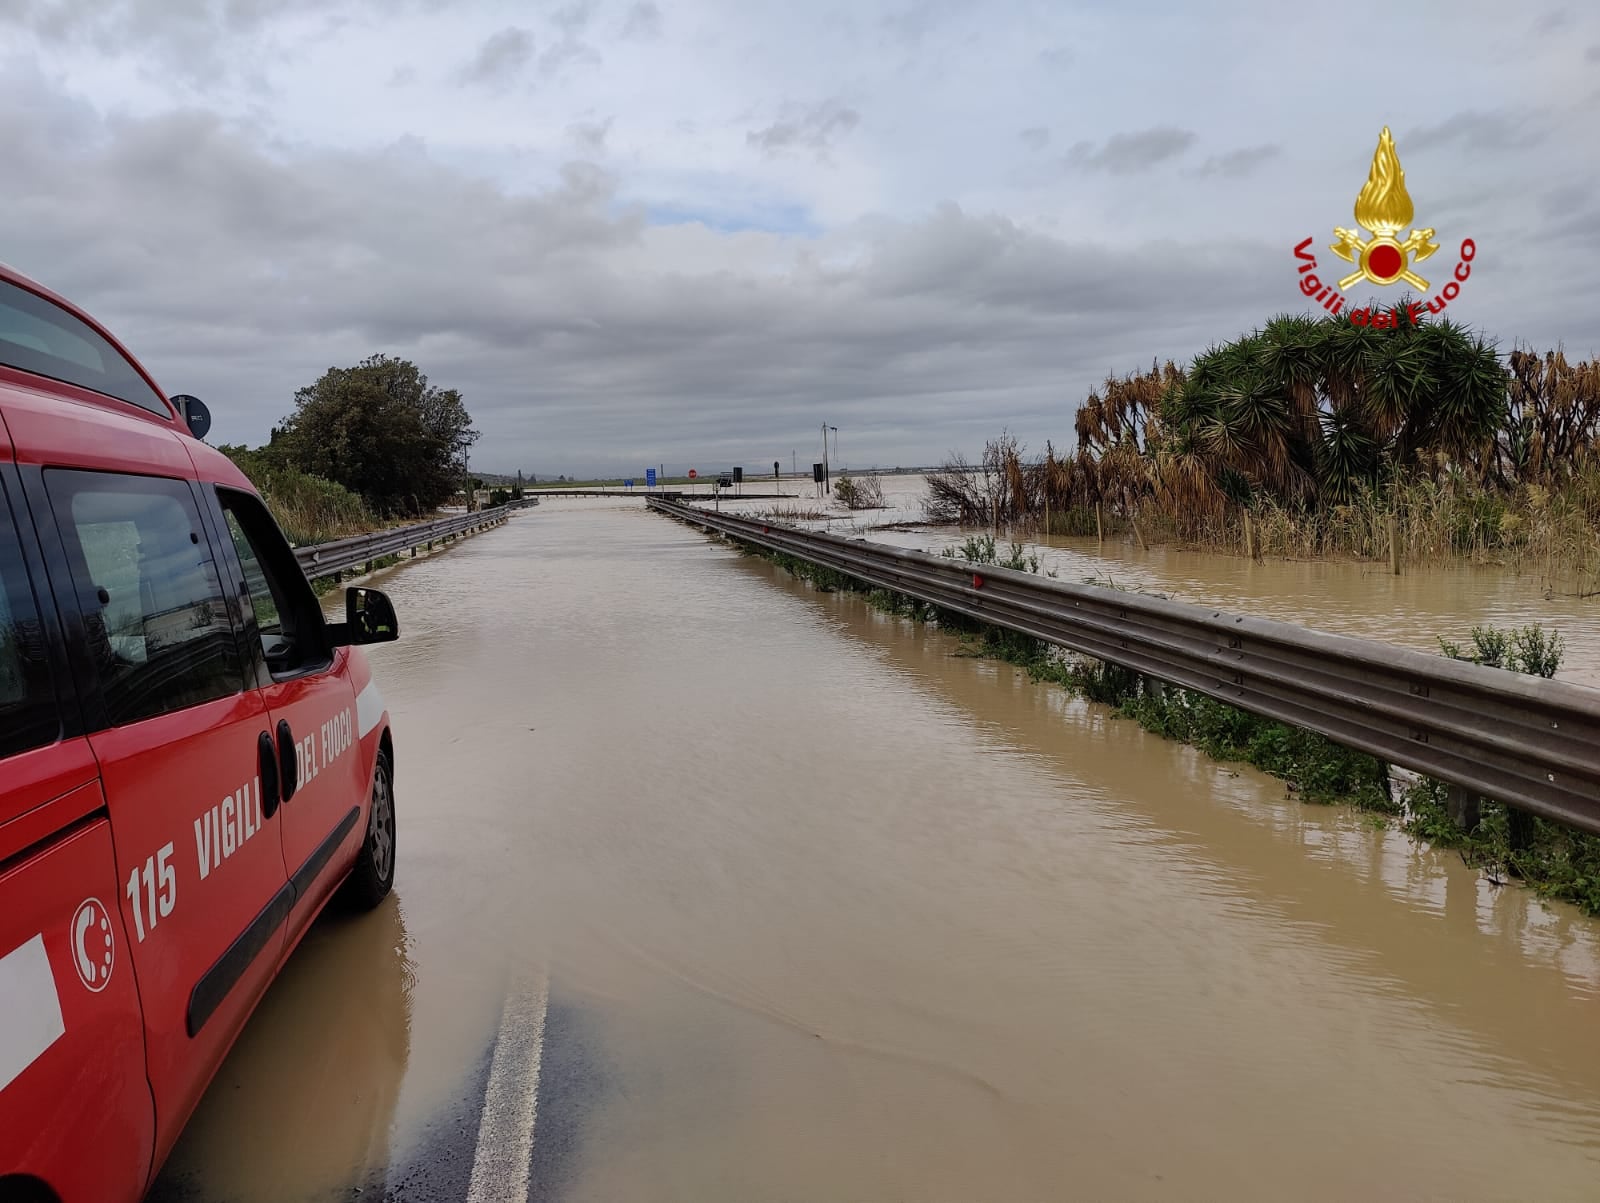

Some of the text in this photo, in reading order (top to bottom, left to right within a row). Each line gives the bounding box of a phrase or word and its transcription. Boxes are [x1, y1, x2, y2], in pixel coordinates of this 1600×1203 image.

[126, 707, 352, 943] 115 VIGILI DEL FUOCO
